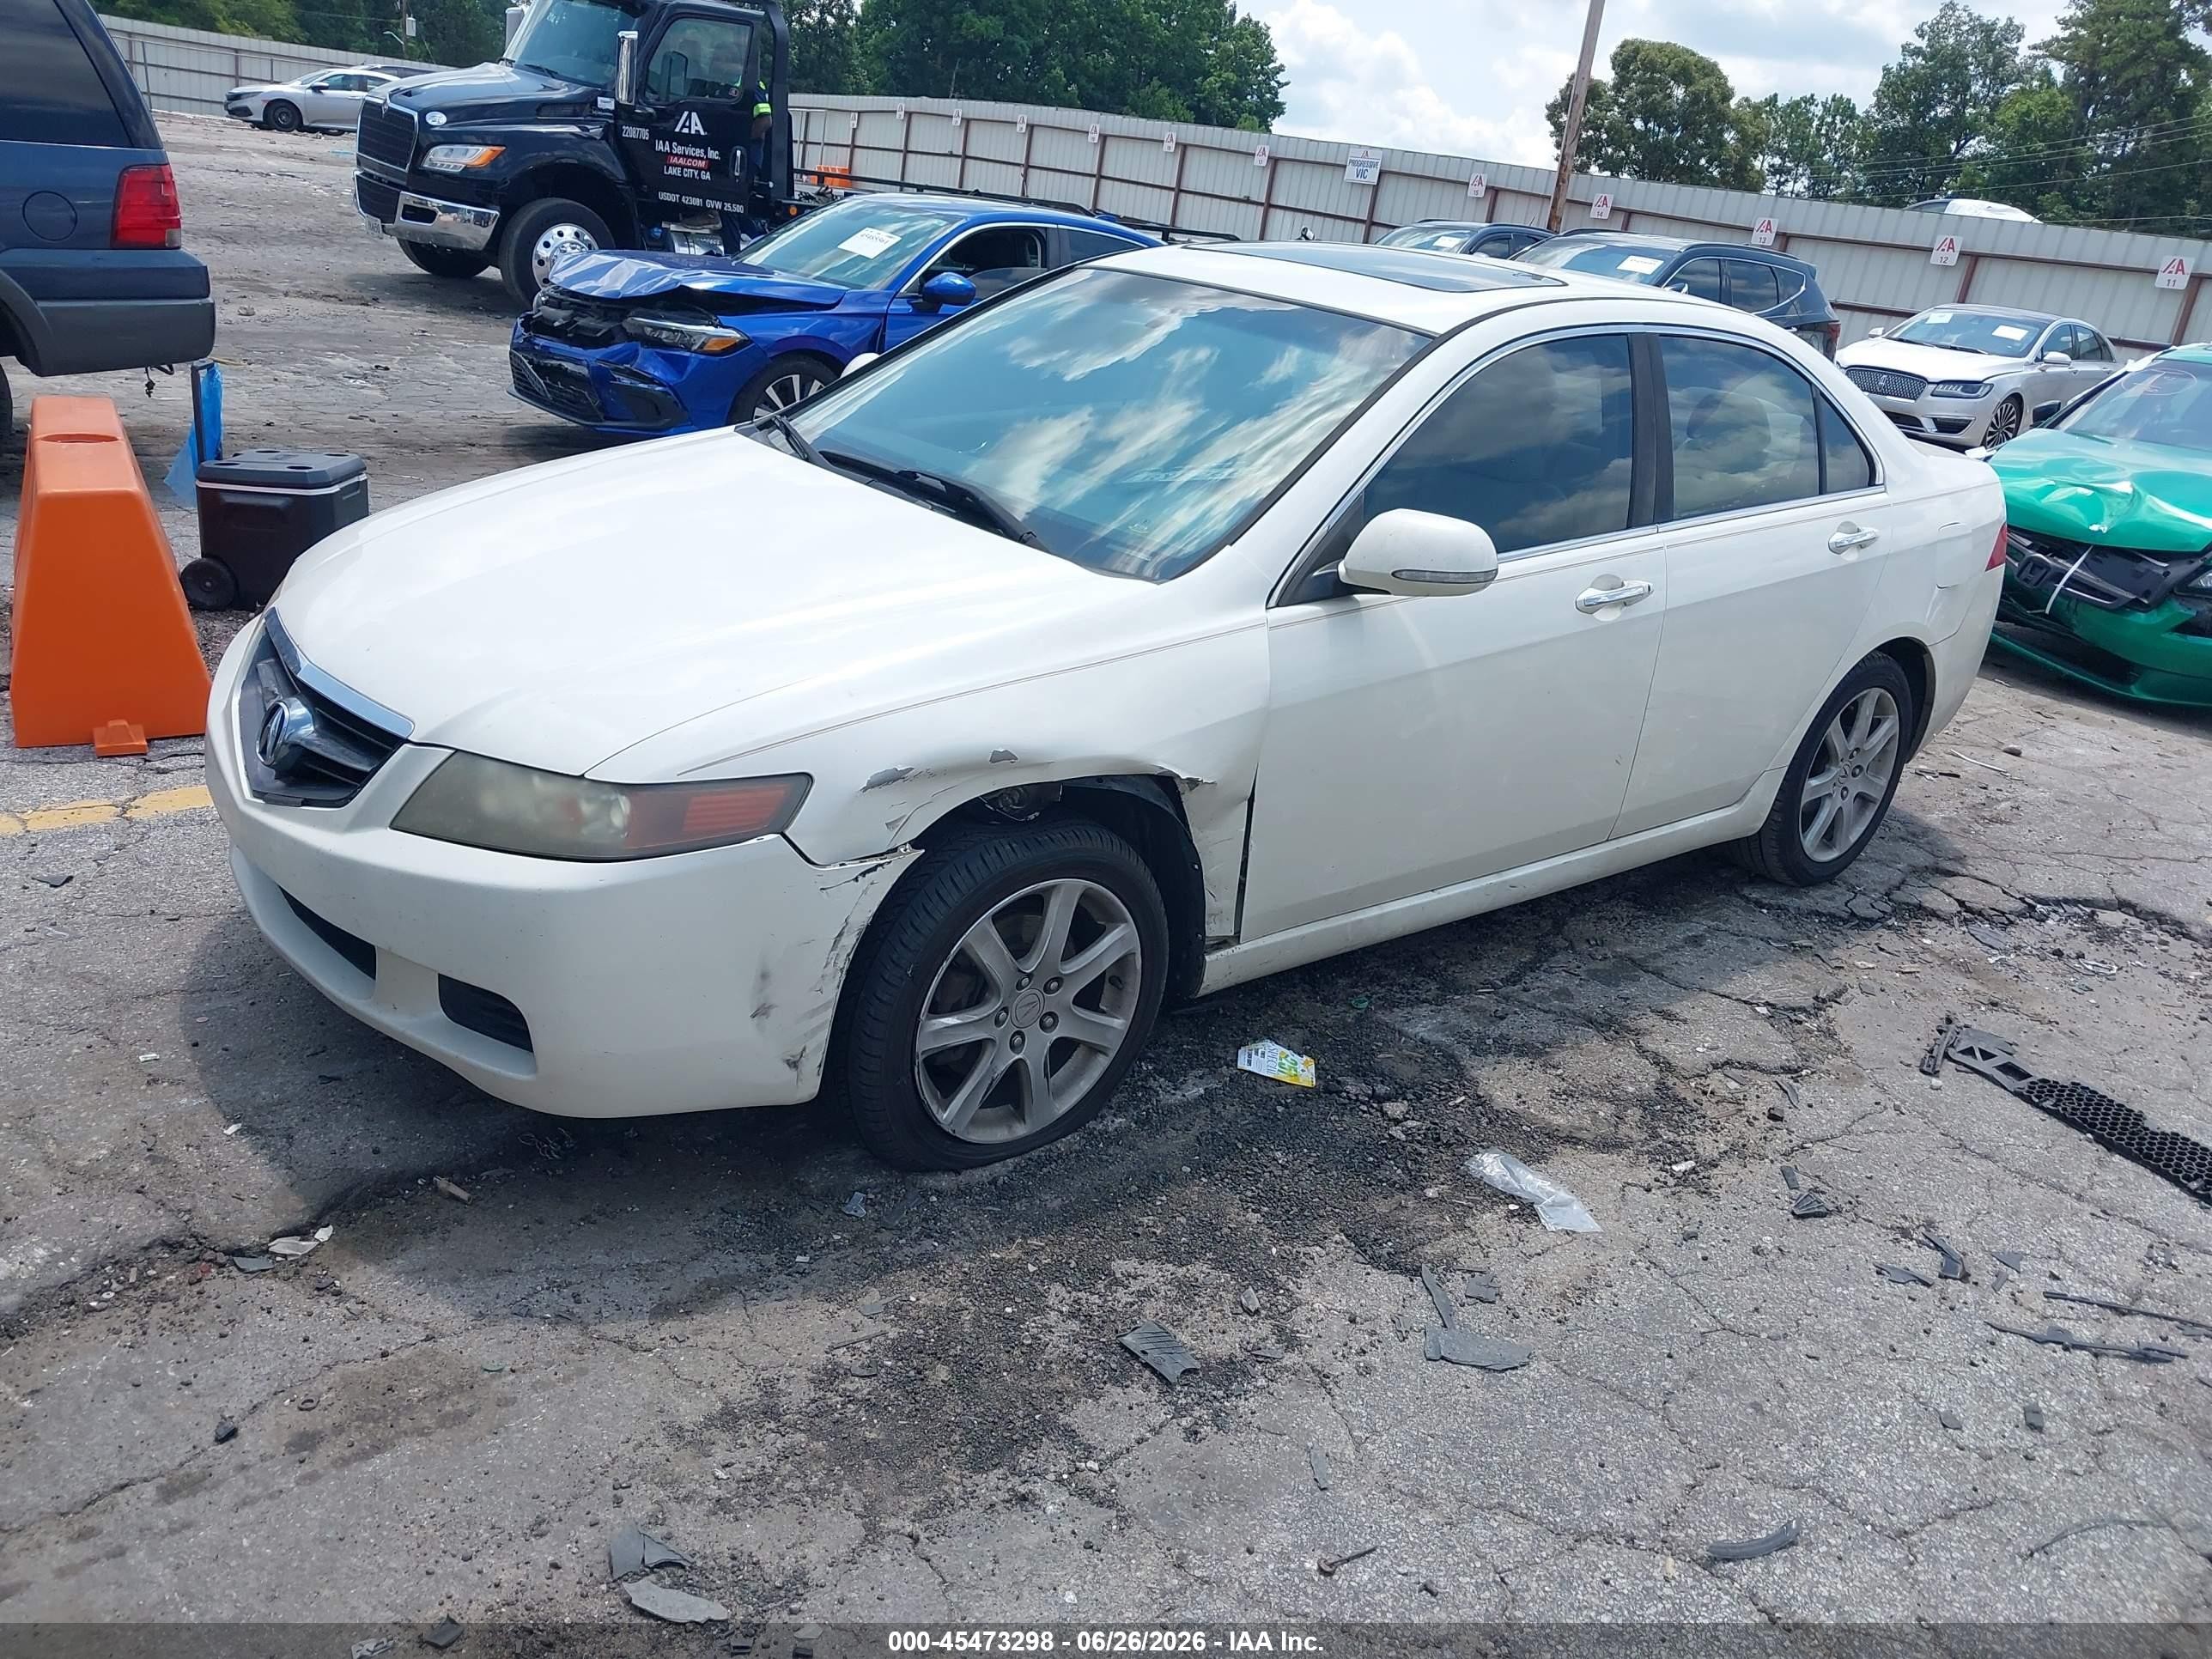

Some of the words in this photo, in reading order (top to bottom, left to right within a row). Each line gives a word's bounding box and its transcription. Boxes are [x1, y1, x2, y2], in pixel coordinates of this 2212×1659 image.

[622, 125, 649, 140] 22087705
[655, 139, 670, 153] IAA
[672, 142, 707, 160] Services,
[708, 147, 721, 161] Inc.
[669, 156, 707, 167] IAAI.COM
[1348, 159, 1380, 170] PROGRESSIVE
[664, 166, 682, 177] LAKE
[683, 167, 699, 180] CITY,
[701, 169, 711, 181] GA
[1355, 168, 1369, 179] VIC
[659, 191, 679, 204] USDOT
[706, 198, 722, 211] GVW
[724, 202, 744, 214] 25,500
[1939, 256, 1949, 264] 12
[2166, 279, 2177, 288] 11
